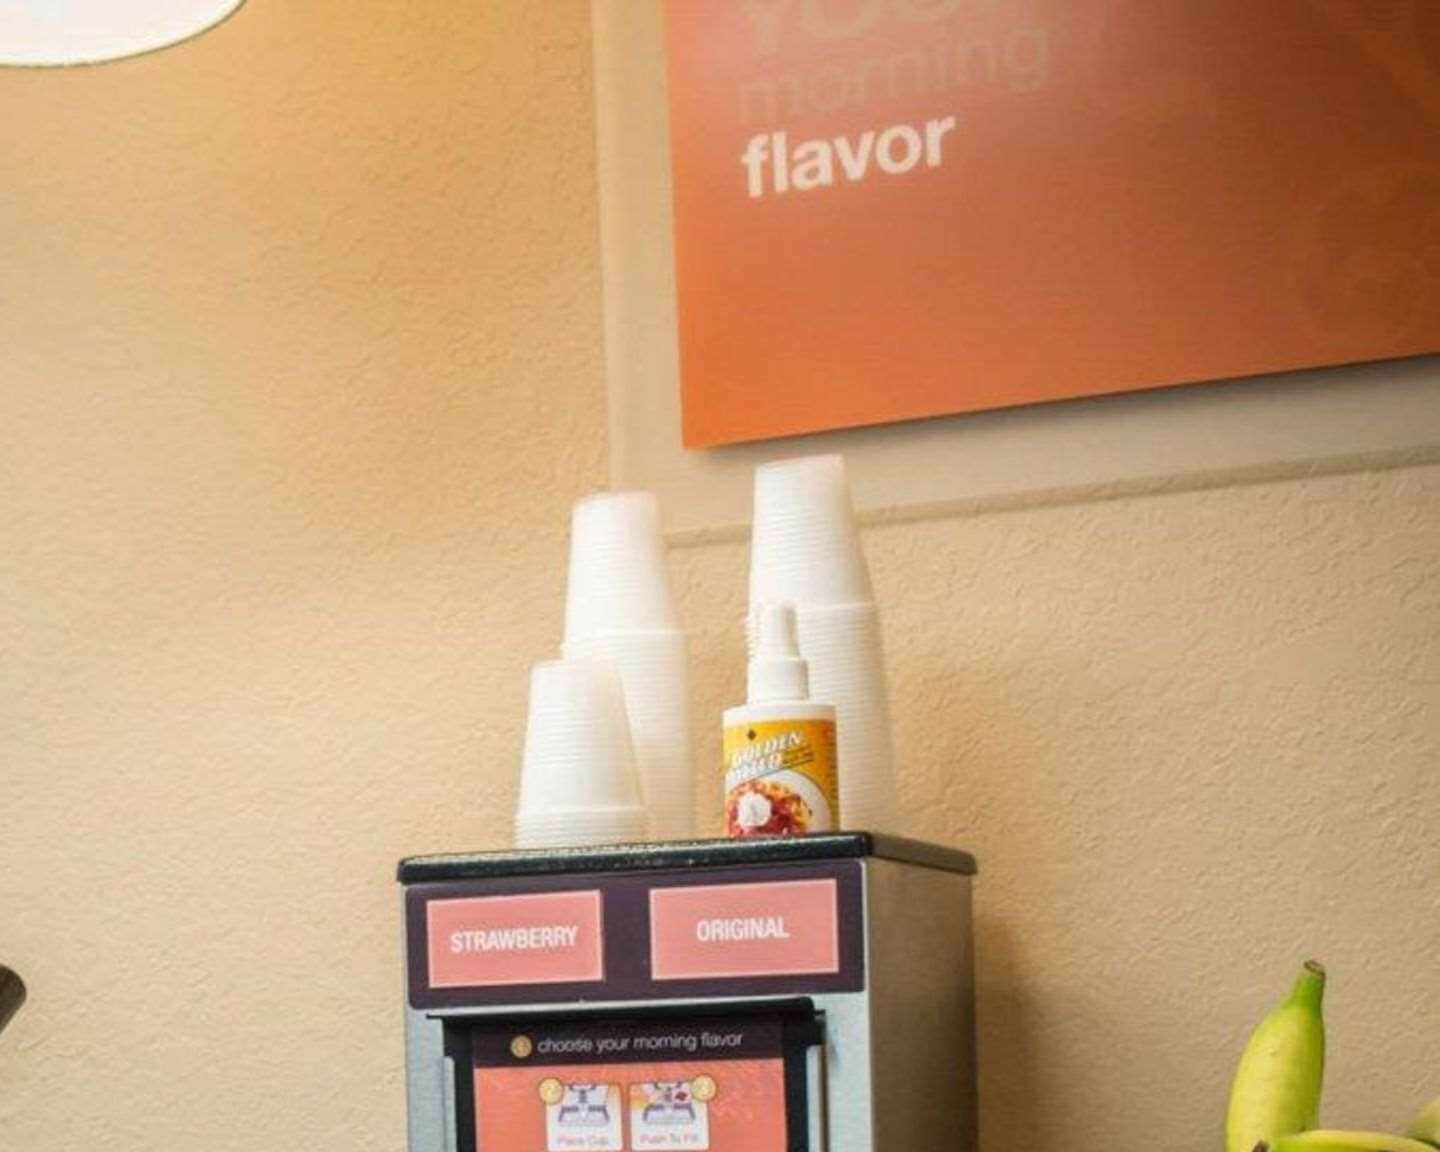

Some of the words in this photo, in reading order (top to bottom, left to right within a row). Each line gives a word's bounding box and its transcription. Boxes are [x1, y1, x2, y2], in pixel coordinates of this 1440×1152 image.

[738, 27, 1048, 123] morning
[740, 116, 956, 197] flavor
[449, 925, 578, 954] STRAWBERRY
[696, 916, 791, 942] ORIGINAL
[537, 1037, 593, 1053] choose
[596, 1038, 629, 1054] your
[634, 1034, 697, 1050] morning
[701, 1032, 743, 1047] flavor
